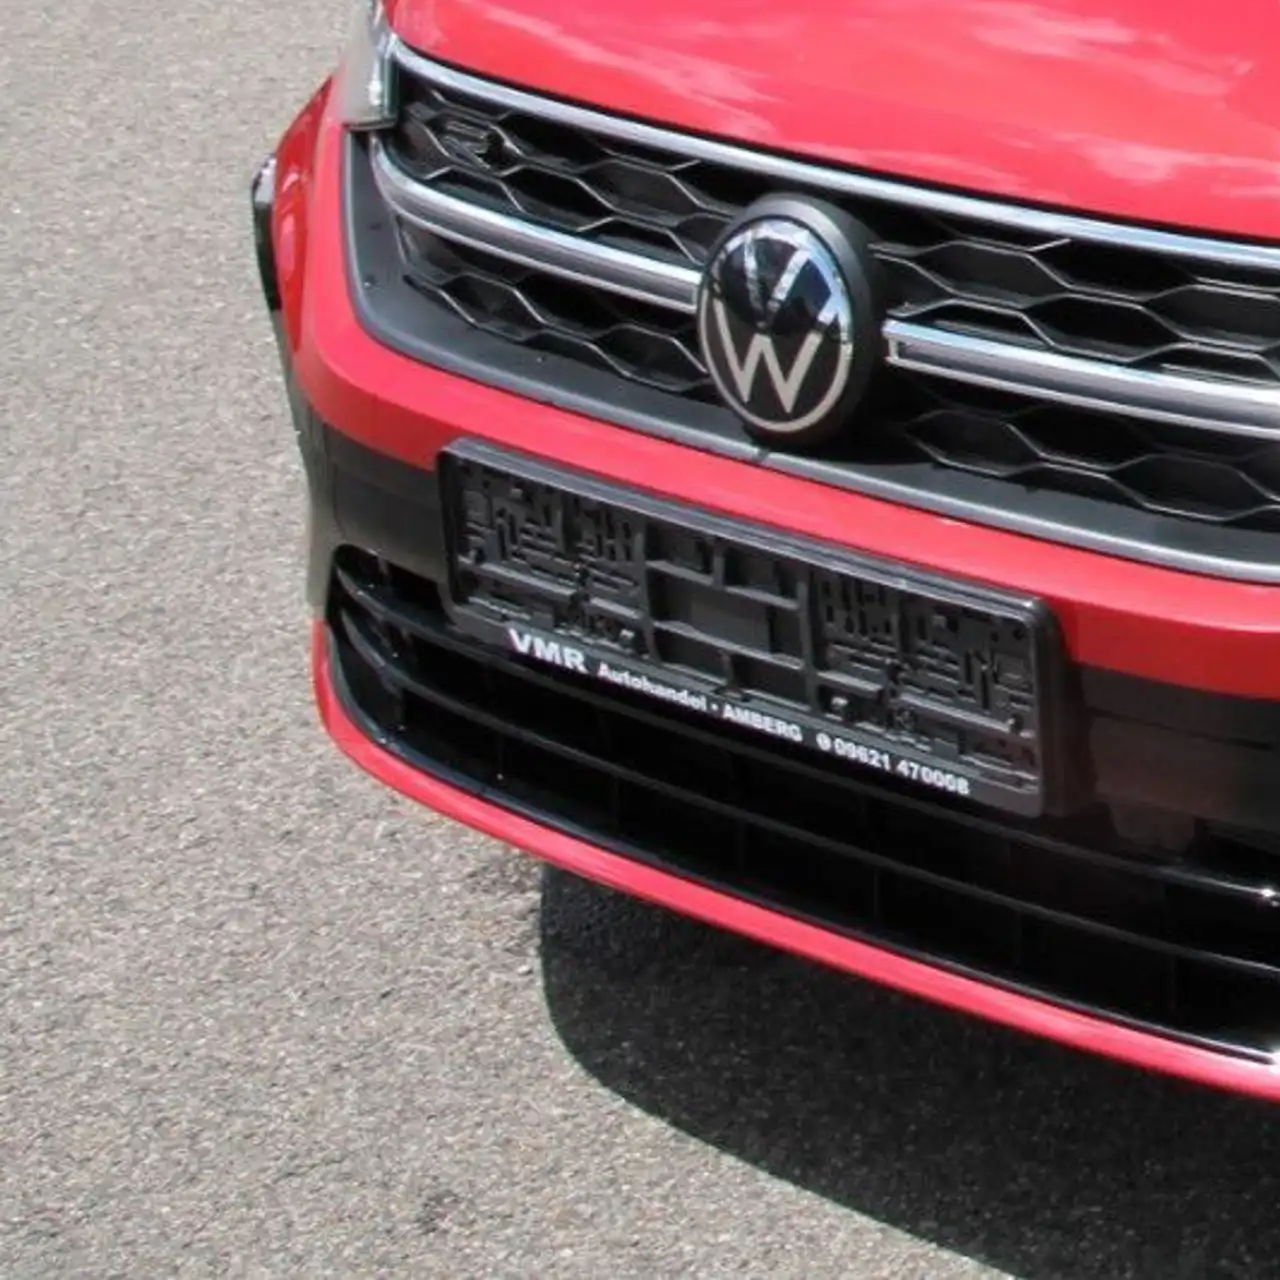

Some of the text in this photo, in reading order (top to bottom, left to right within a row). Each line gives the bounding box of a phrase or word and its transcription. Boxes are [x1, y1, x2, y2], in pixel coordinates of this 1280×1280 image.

[508, 628, 589, 674] VMR
[597, 663, 707, 712] Autohandel
[722, 704, 804, 743] AMBERG
[834, 736, 892, 771] 09621
